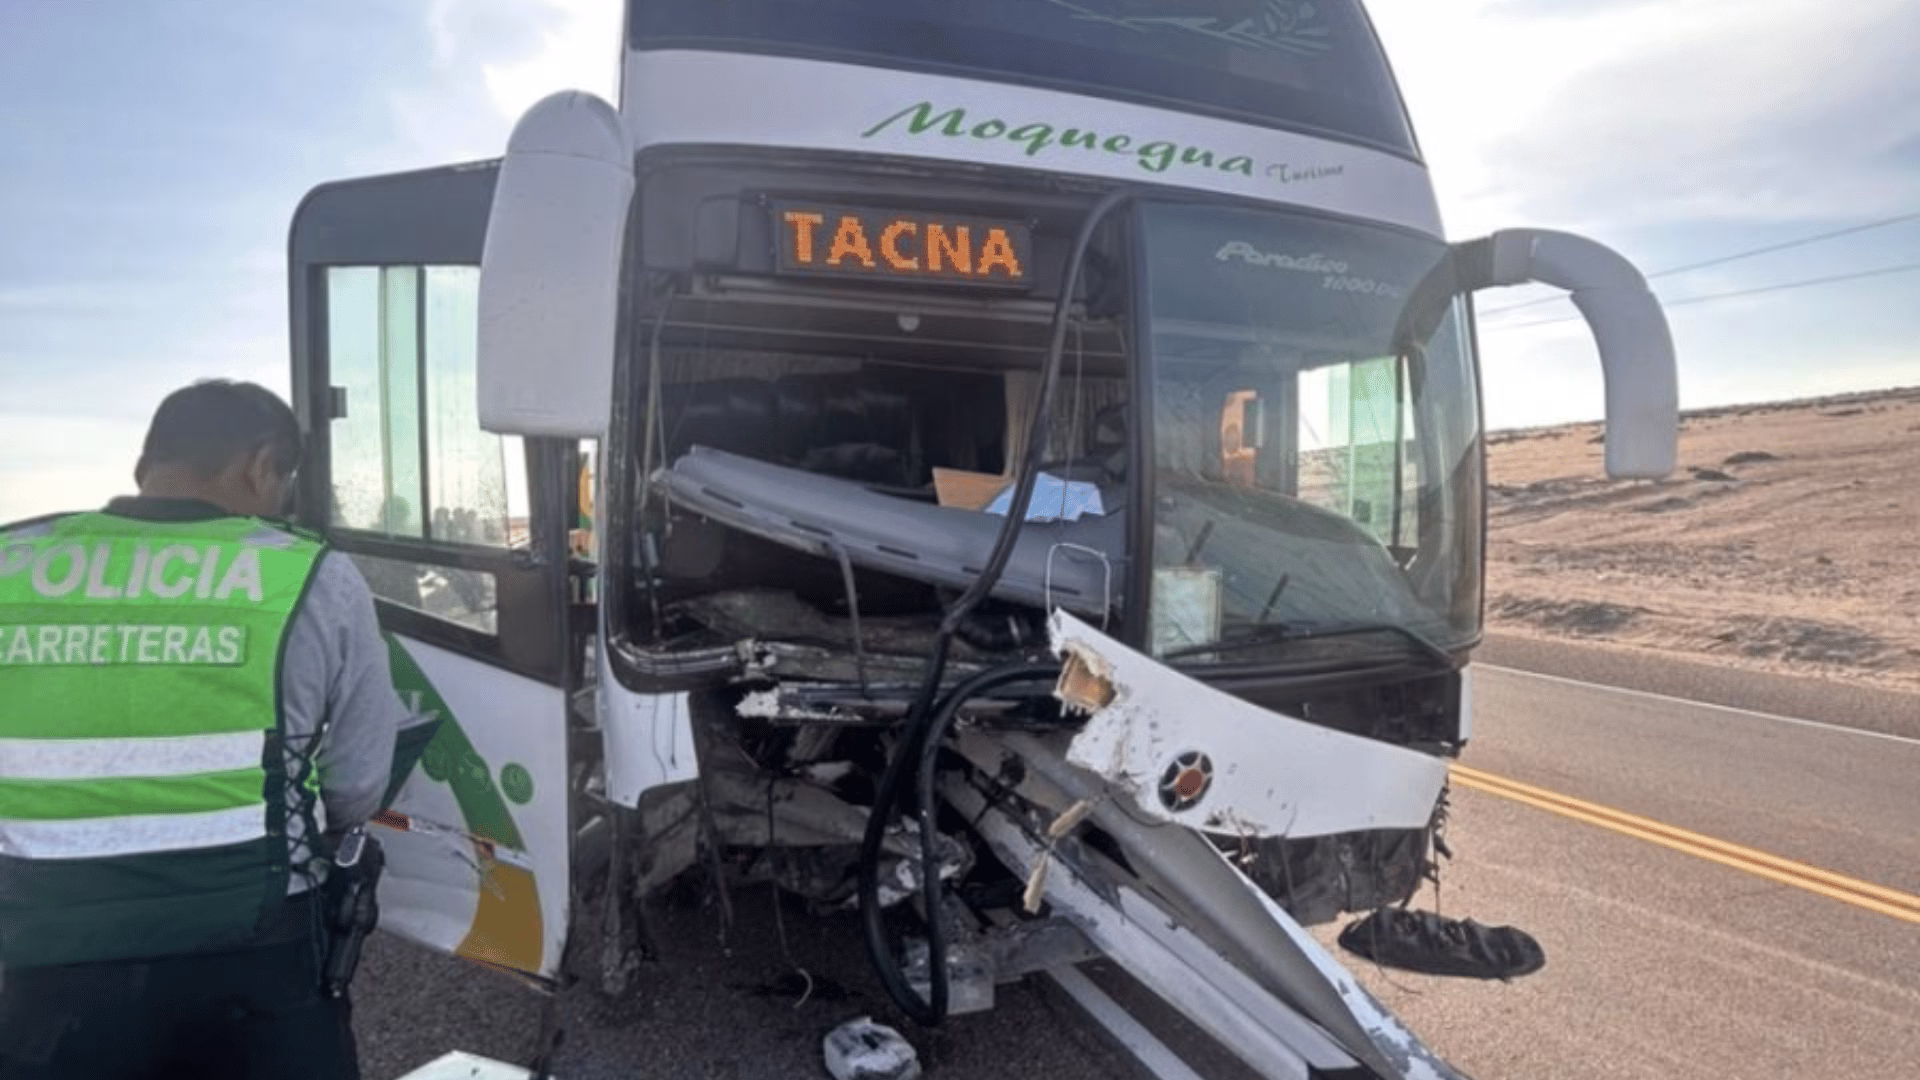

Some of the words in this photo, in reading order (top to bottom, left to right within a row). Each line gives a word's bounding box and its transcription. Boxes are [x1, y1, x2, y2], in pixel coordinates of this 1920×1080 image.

[861, 101, 1253, 176] Moquegua
[785, 212, 1022, 277] TACNA
[0, 544, 263, 601] POLICIA
[0, 624, 240, 664] ARRETERAS
